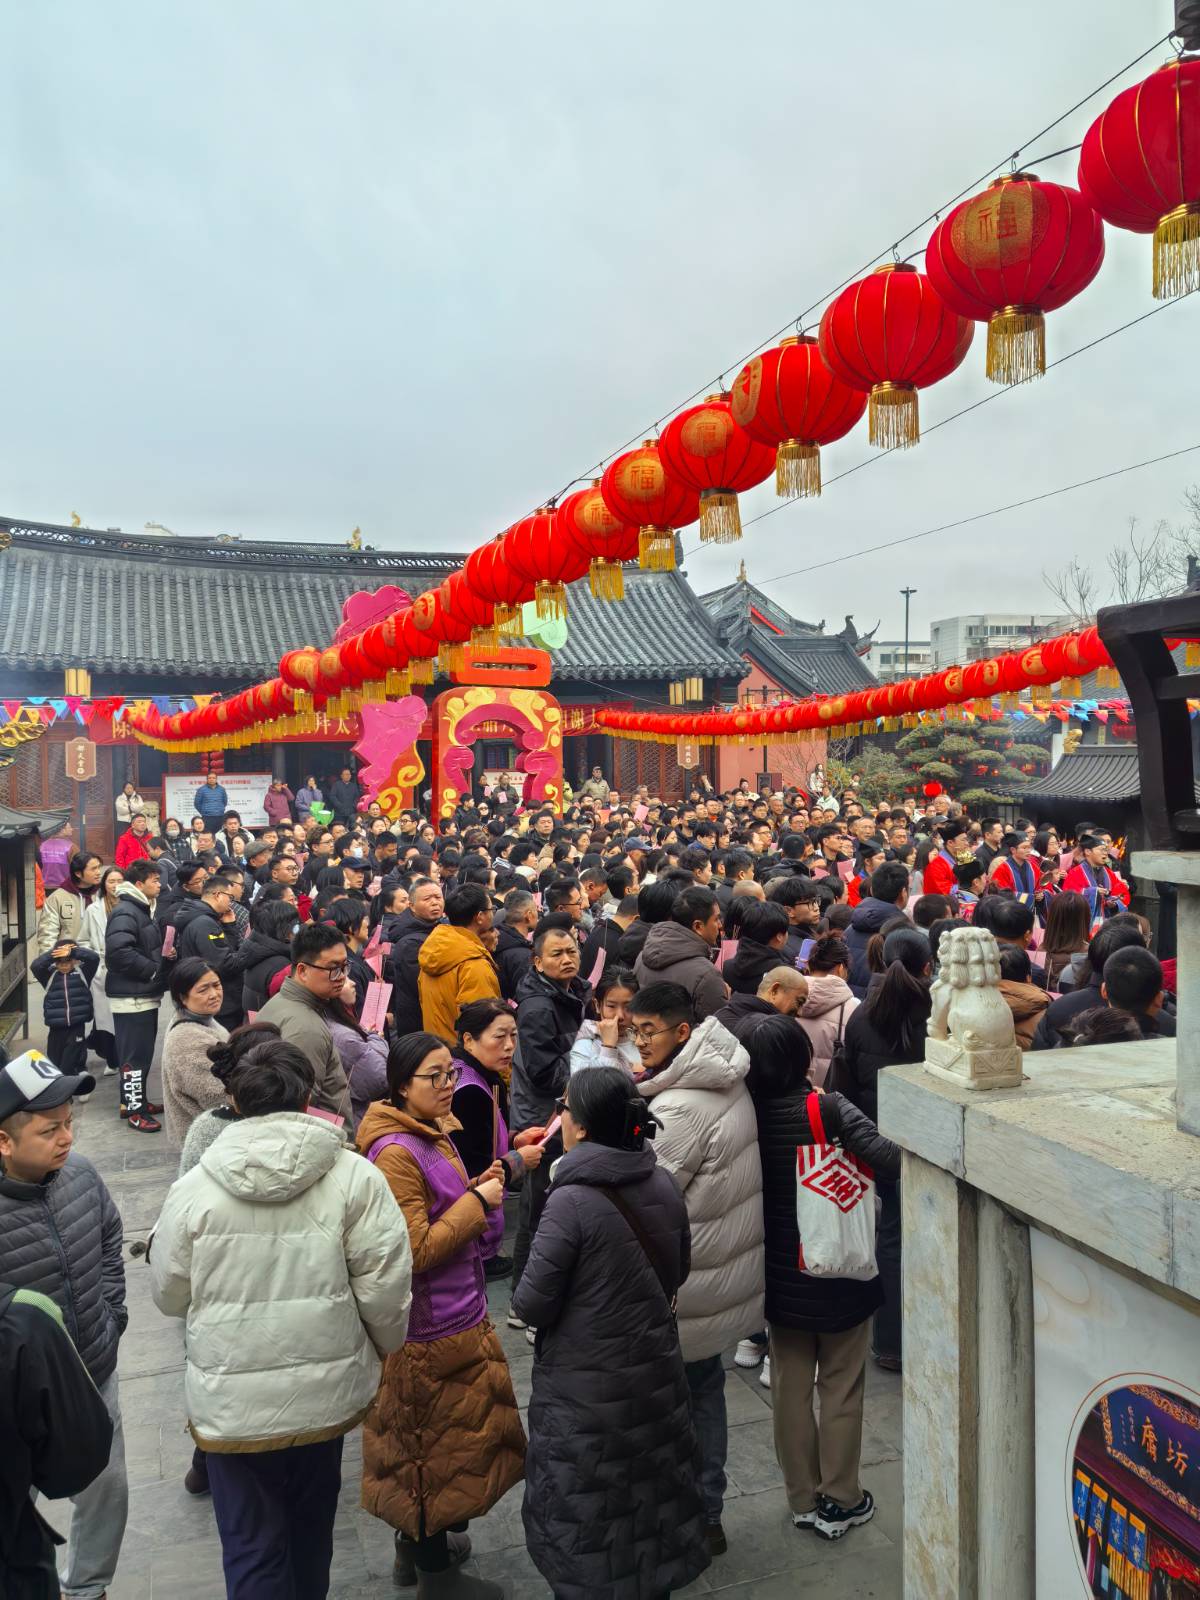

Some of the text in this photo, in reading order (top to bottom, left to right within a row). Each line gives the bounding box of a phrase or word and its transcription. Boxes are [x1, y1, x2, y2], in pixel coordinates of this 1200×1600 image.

[977, 200, 1019, 242] 福
[630, 464, 656, 491] 福
[590, 503, 613, 526] 福
